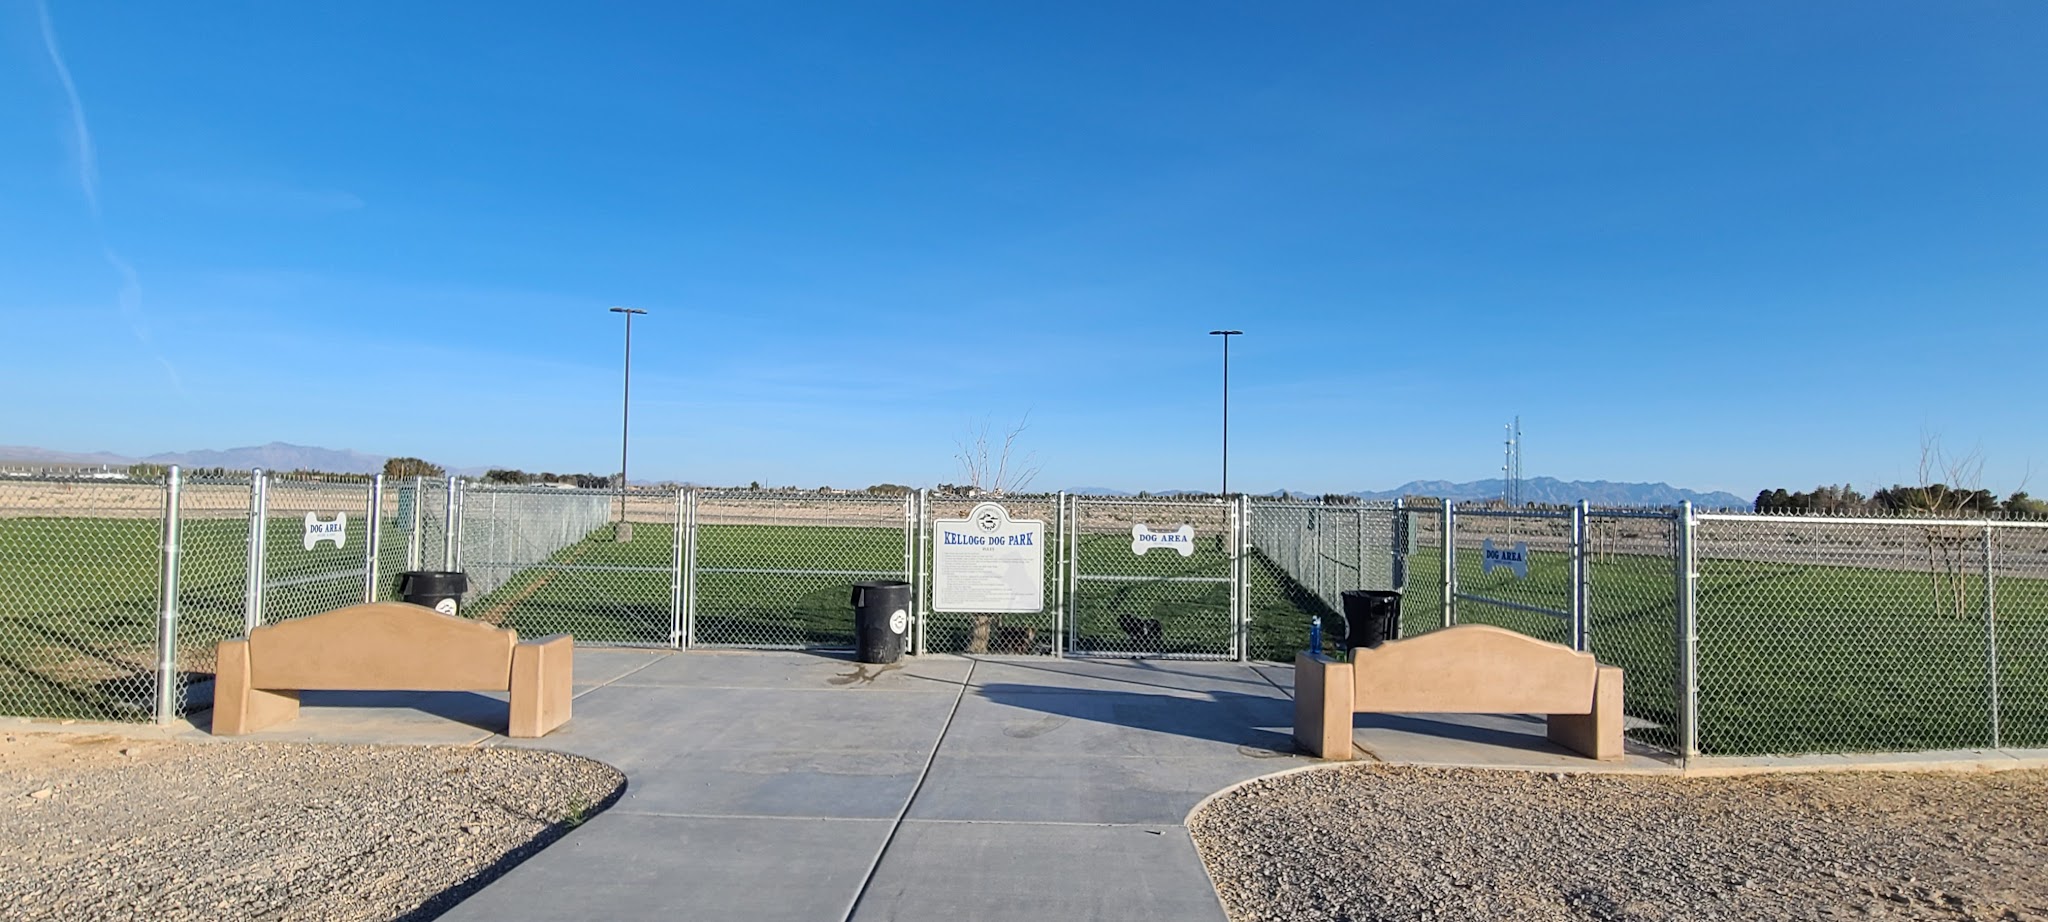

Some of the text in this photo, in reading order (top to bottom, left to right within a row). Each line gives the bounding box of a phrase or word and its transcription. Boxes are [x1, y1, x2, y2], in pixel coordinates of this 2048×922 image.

[310, 524, 342, 533] DOG AREA
[944, 531, 1033, 546] KELLOGG DOG PARK
[1486, 550, 1522, 562] DOG AREA
